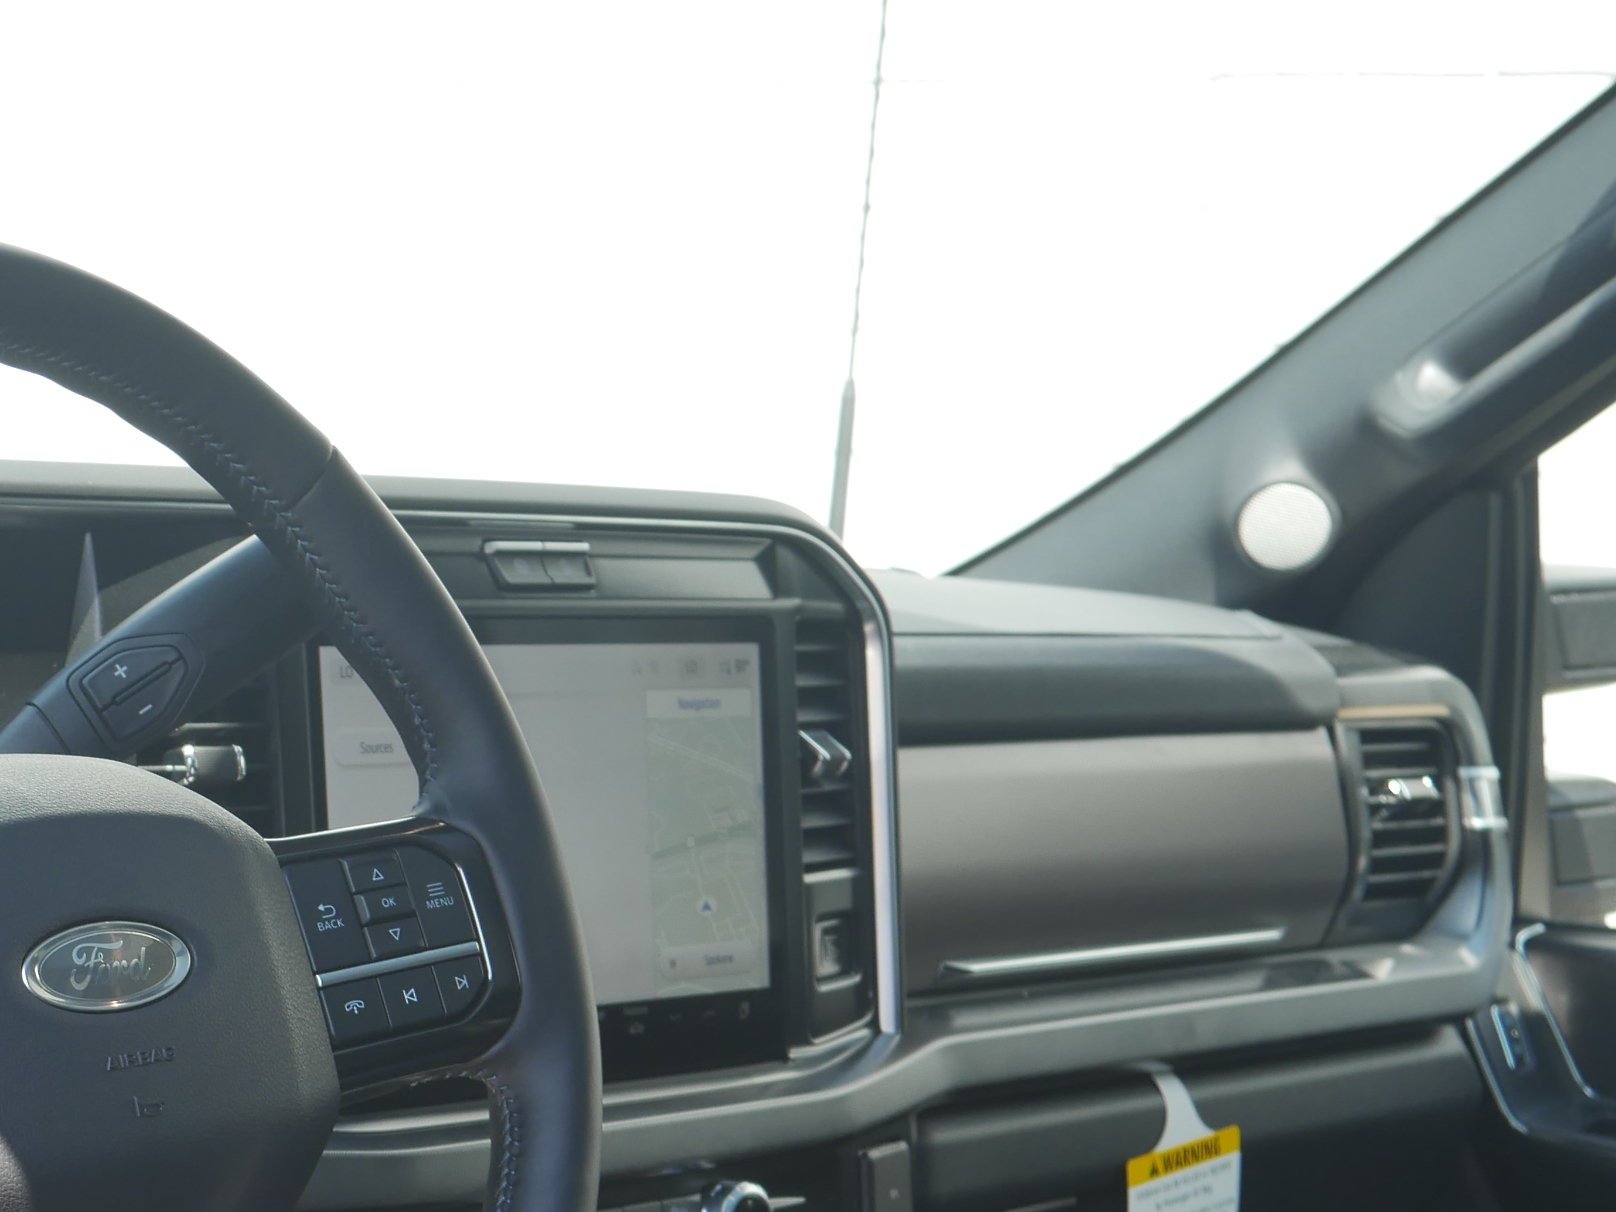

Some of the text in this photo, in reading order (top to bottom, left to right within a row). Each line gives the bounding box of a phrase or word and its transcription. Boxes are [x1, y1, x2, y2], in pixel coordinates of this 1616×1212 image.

[360, 741, 394, 754] Sources
[381, 896, 397, 908] OK
[425, 896, 454, 910] MENU
[317, 918, 345, 931] BACK
[70, 940, 152, 991] Ford
[106, 1047, 176, 1071] AIRBAG
[1164, 1136, 1222, 1174] WARNING
